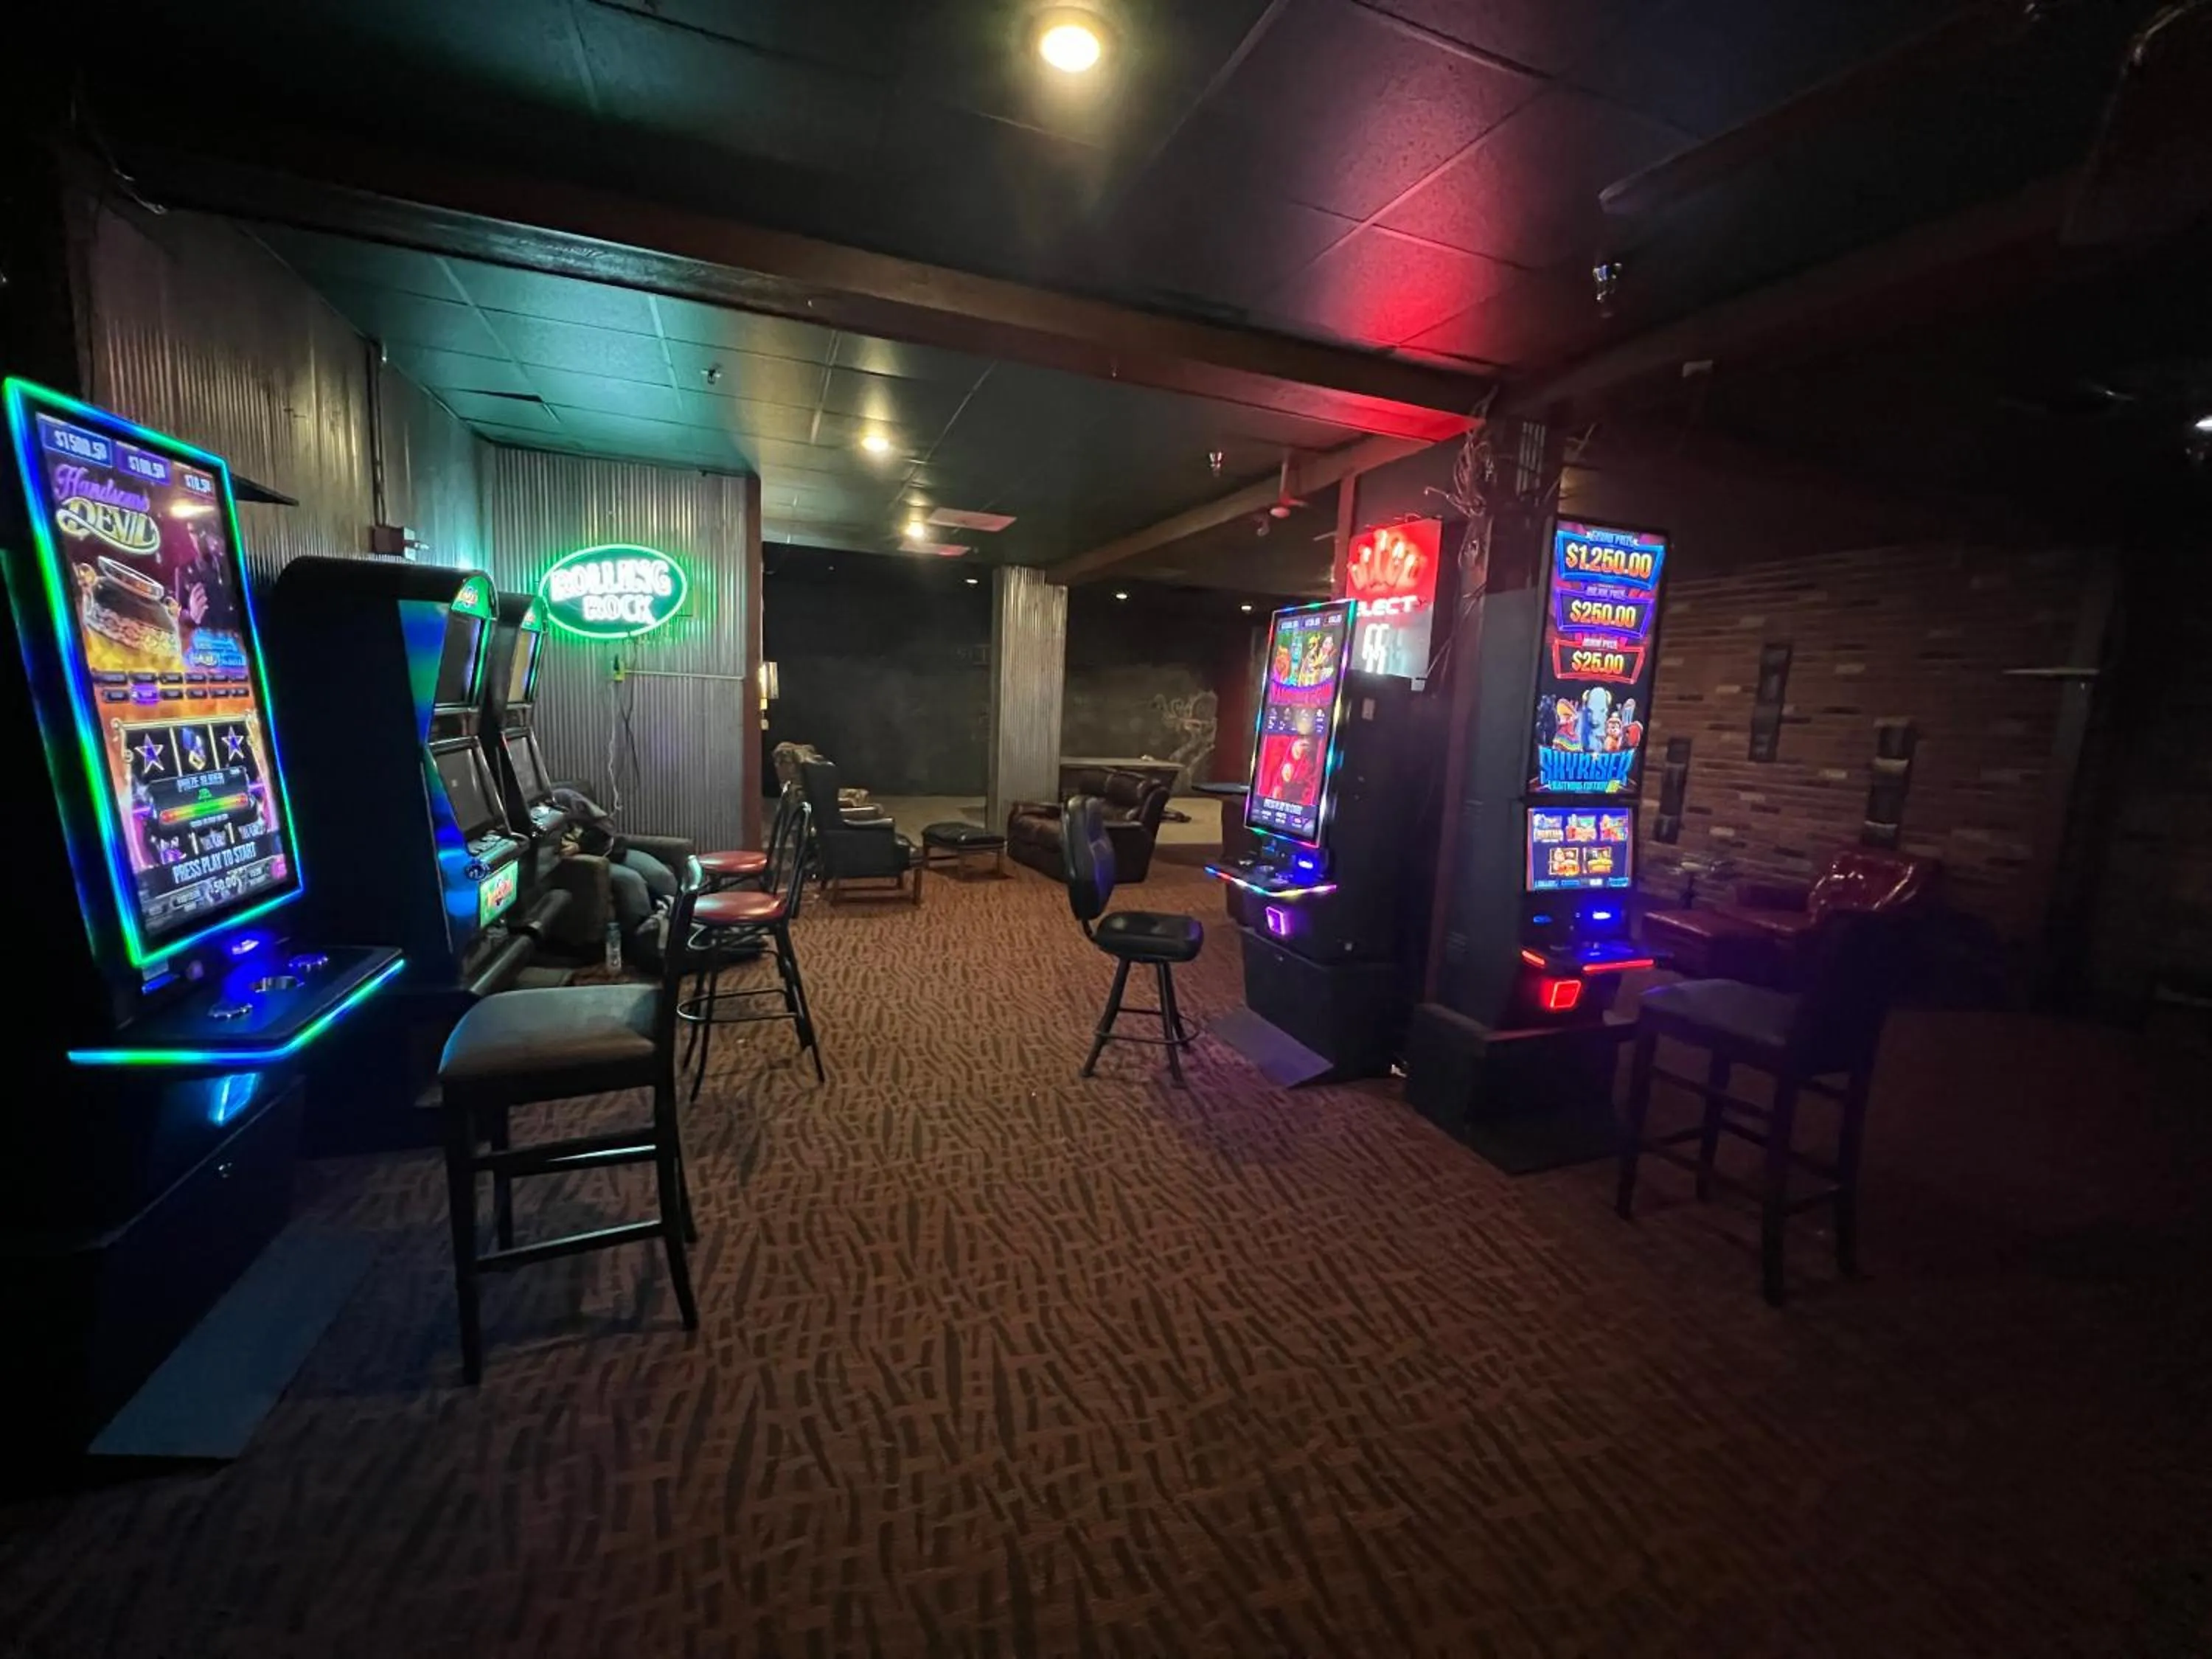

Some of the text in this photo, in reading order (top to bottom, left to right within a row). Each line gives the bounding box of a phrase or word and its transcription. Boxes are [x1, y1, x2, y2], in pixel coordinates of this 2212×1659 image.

[552, 559, 672, 602] ROLLING
[582, 594, 657, 626] ROCK
[1357, 594, 1418, 617] LECT
[1570, 599, 1636, 628] $250.00
[1571, 650, 1625, 675] $25.00
[173, 841, 257, 884] PRESS PLAY TO START
